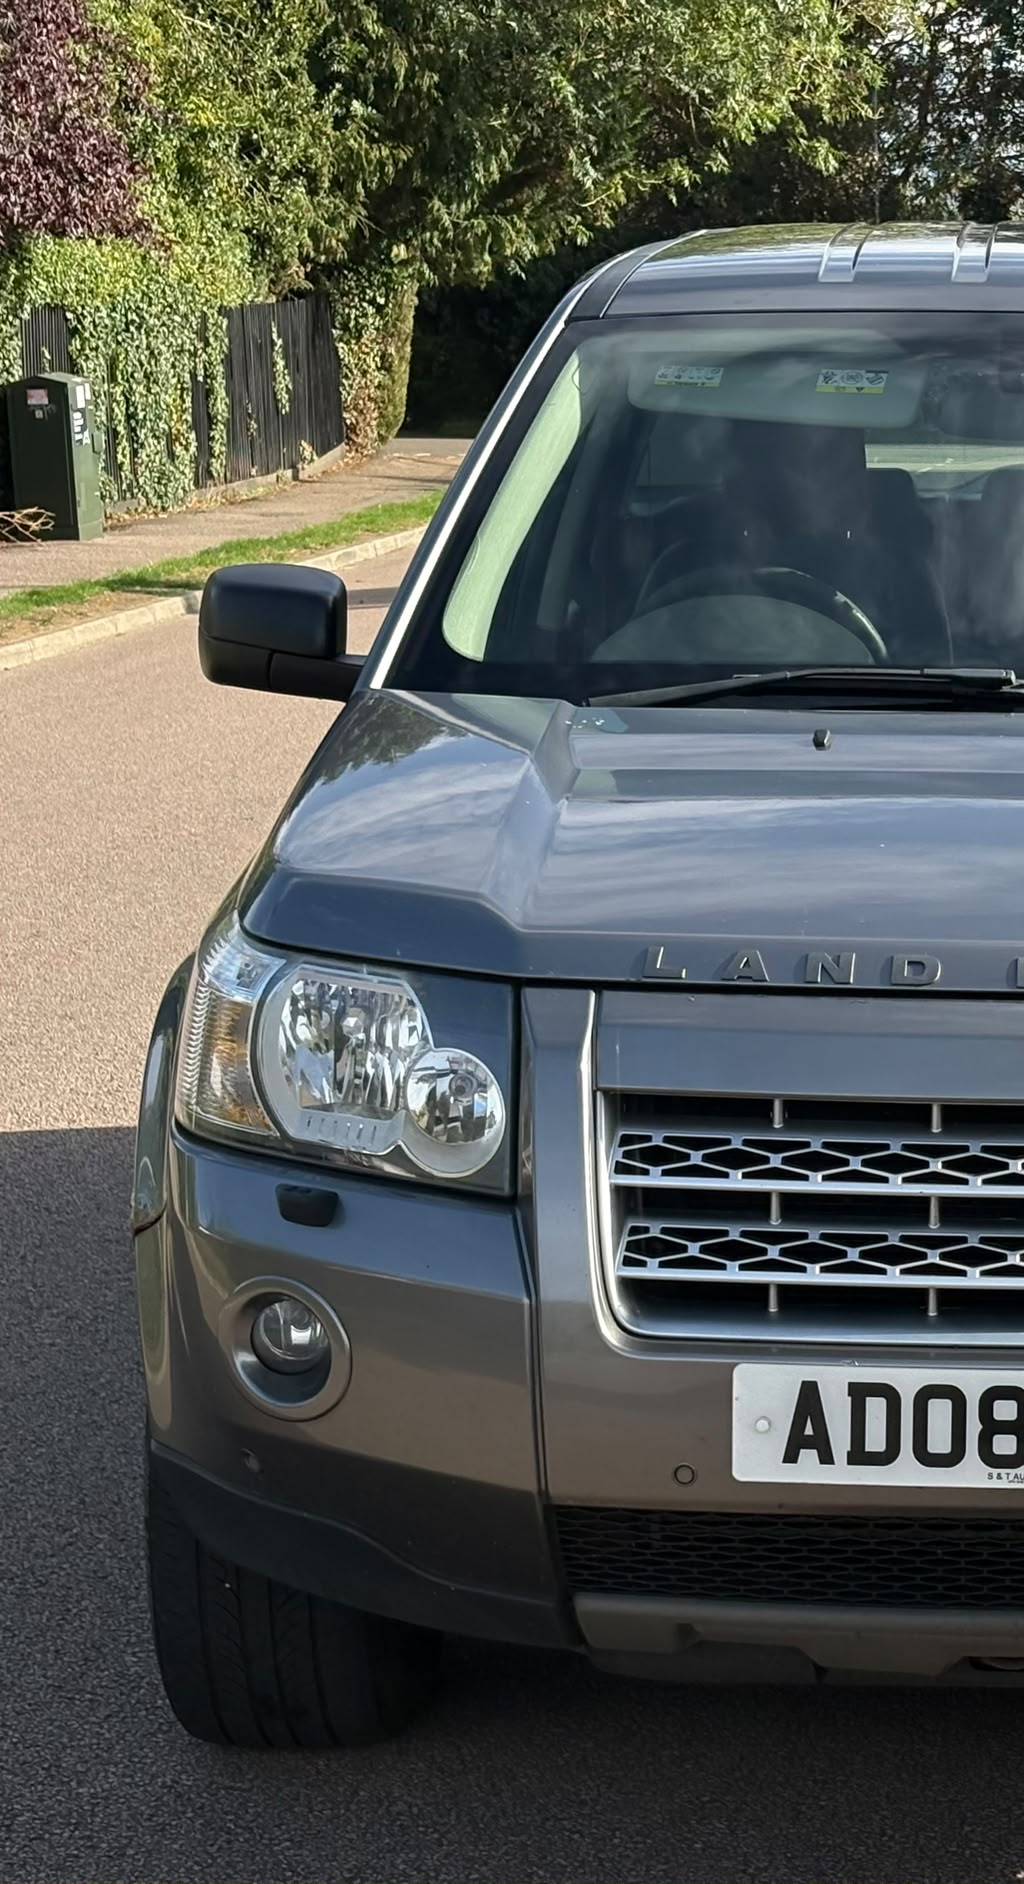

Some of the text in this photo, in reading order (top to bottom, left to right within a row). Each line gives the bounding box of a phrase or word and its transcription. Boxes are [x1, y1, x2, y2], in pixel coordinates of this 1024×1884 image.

[642, 946, 944, 986] LAND
[987, 1472, 994, 1480] S
[996, 1472, 1003, 1480] &
[1005, 1472, 1011, 1480] T
